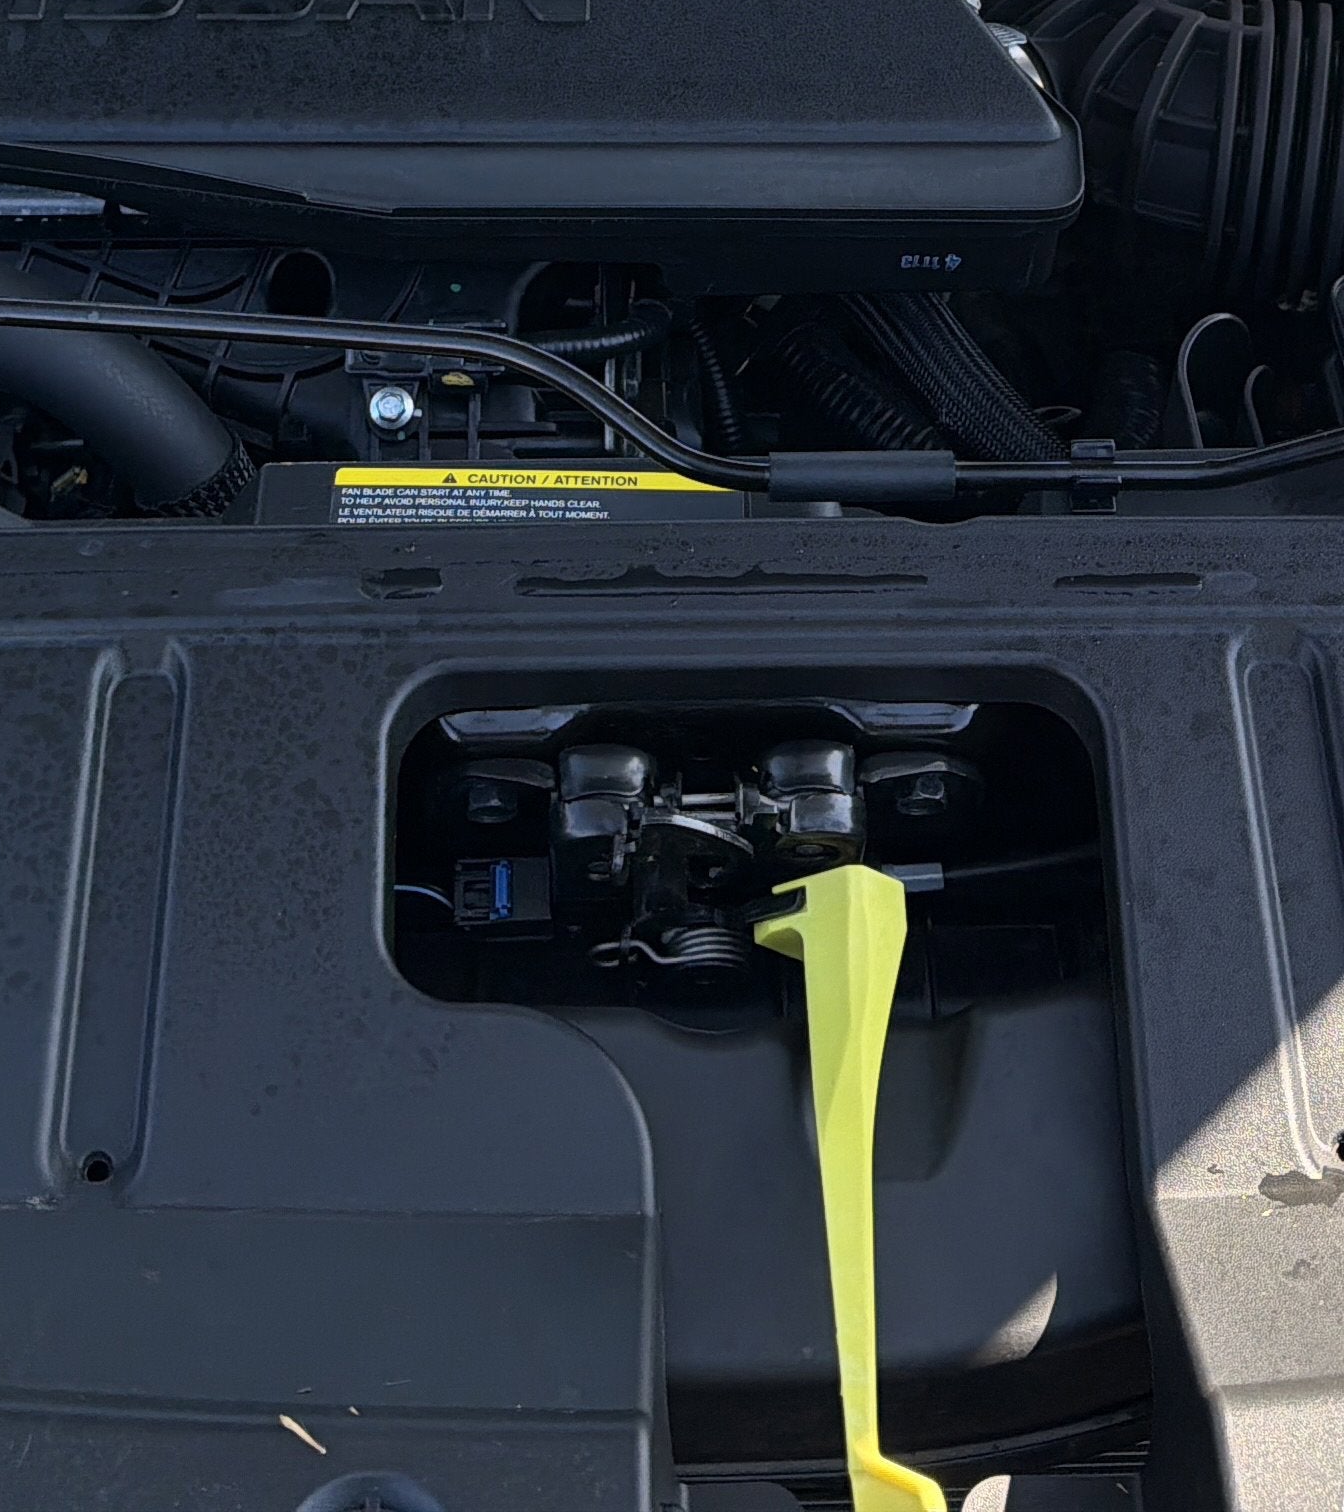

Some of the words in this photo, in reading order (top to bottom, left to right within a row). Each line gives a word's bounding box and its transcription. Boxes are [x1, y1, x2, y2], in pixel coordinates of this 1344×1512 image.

[467, 473, 537, 485] CAUTION
[553, 474, 639, 487] ATTENTION
[342, 488, 361, 496] FAN
[362, 488, 395, 496] BLADE
[397, 488, 418, 496] CAN
[420, 488, 450, 496] START
[451, 489, 464, 497] AT
[465, 489, 487, 497] ANY
[340, 497, 354, 505] TO
[356, 497, 382, 505] HELP
[382, 497, 413, 505] AVOID
[414, 498, 467, 506] PERSONAL
[530, 499, 566, 508] HANDS
[338, 508, 351, 516] LE
[352, 508, 416, 516] VENTILATEUR
[417, 509, 455, 517] RISQUE
[456, 509, 471, 517] DE
[472, 508, 527, 518] DÉMARRER
[538, 510, 564, 518] TOUT
[565, 511, 611, 520] MOMENT.
